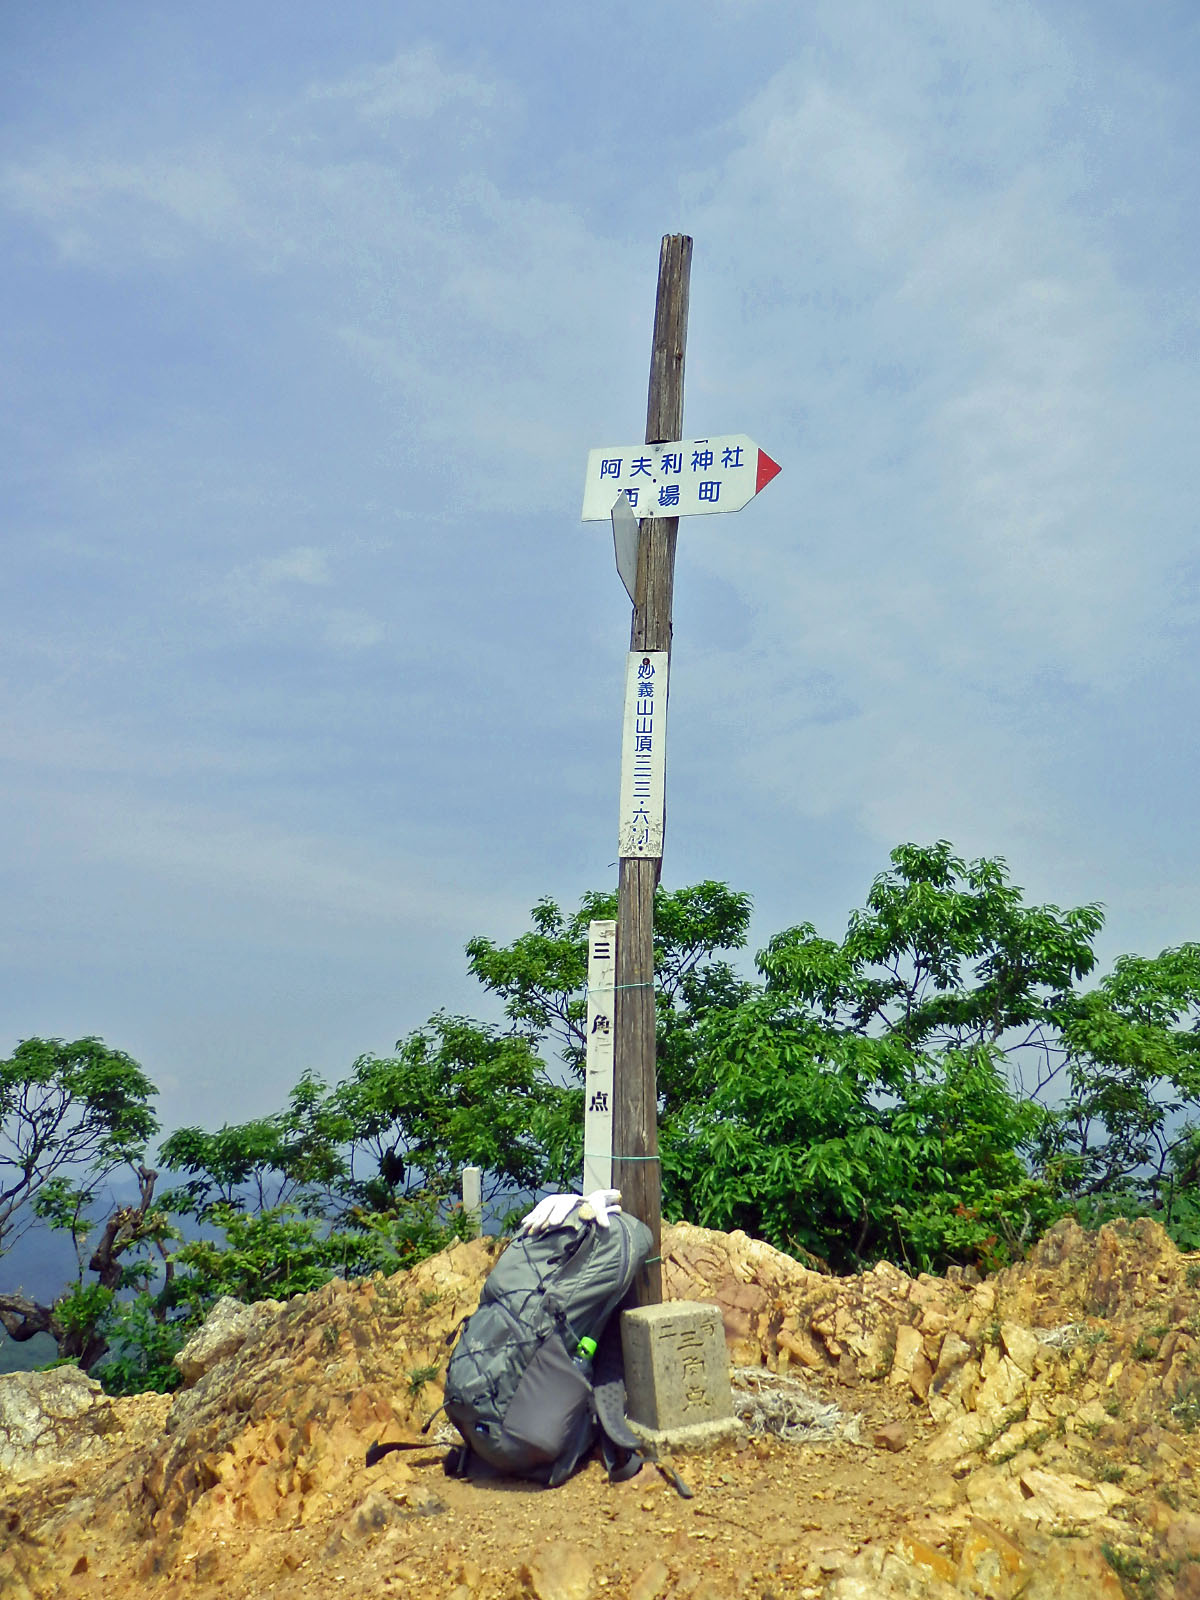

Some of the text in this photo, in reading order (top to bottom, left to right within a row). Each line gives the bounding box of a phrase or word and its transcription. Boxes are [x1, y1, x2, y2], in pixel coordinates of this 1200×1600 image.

[600, 446, 744, 479] 阿夫利神社
[589, 942, 610, 1111] 三角点
